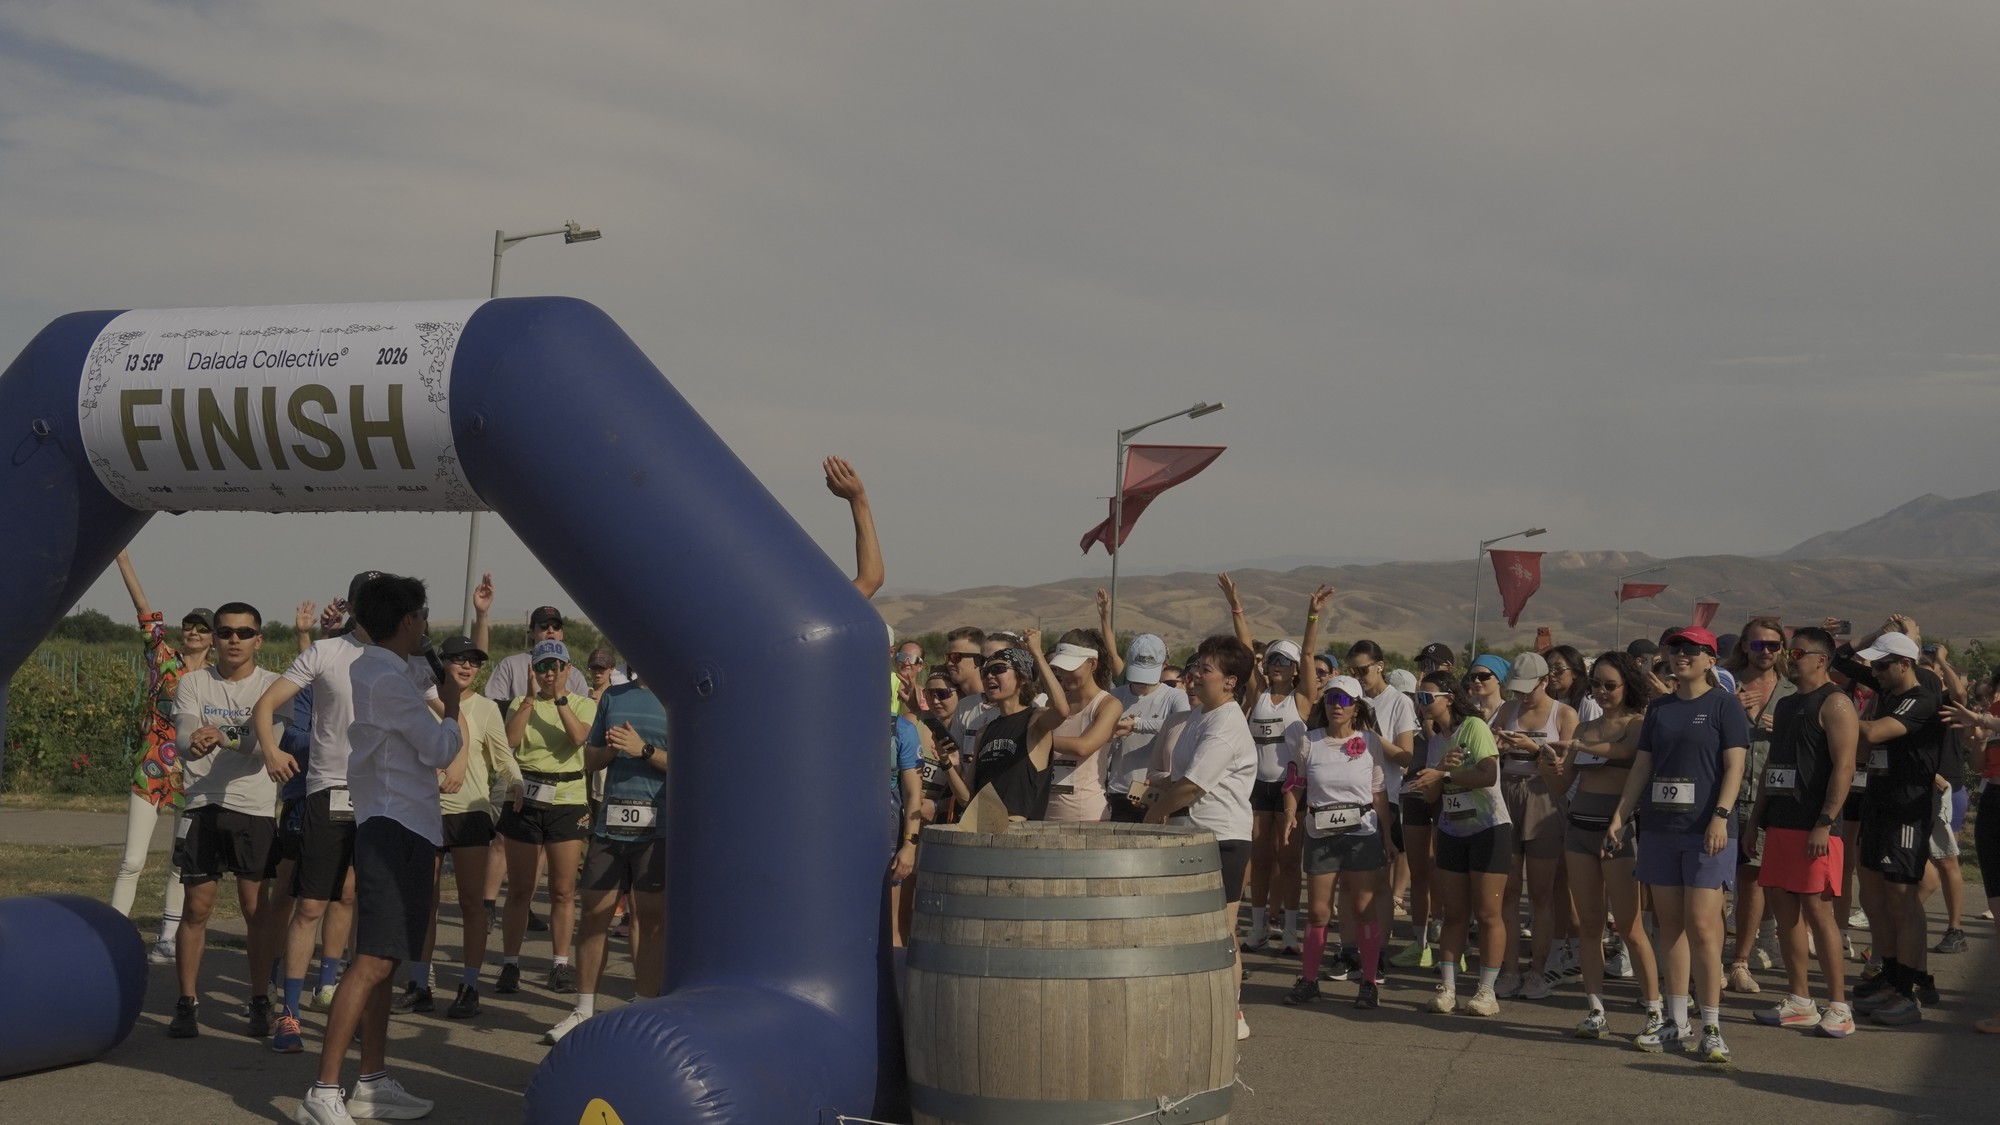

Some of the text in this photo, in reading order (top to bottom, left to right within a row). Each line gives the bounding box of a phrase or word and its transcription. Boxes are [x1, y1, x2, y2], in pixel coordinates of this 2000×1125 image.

[125, 354, 140, 371] 13
[140, 353, 164, 371] SEP
[187, 352, 248, 370] Dalada
[376, 347, 408, 365] 2026
[120, 384, 416, 472] FINISH
[203, 705, 252, 717] Битрикс2
[1260, 725, 1272, 736] 75
[922, 766, 937, 780] 81
[526, 784, 540, 797] 17
[1662, 785, 1678, 800] 99
[1447, 796, 1461, 809] 94
[621, 808, 640, 823] 30
[1329, 812, 1347, 825] 44
